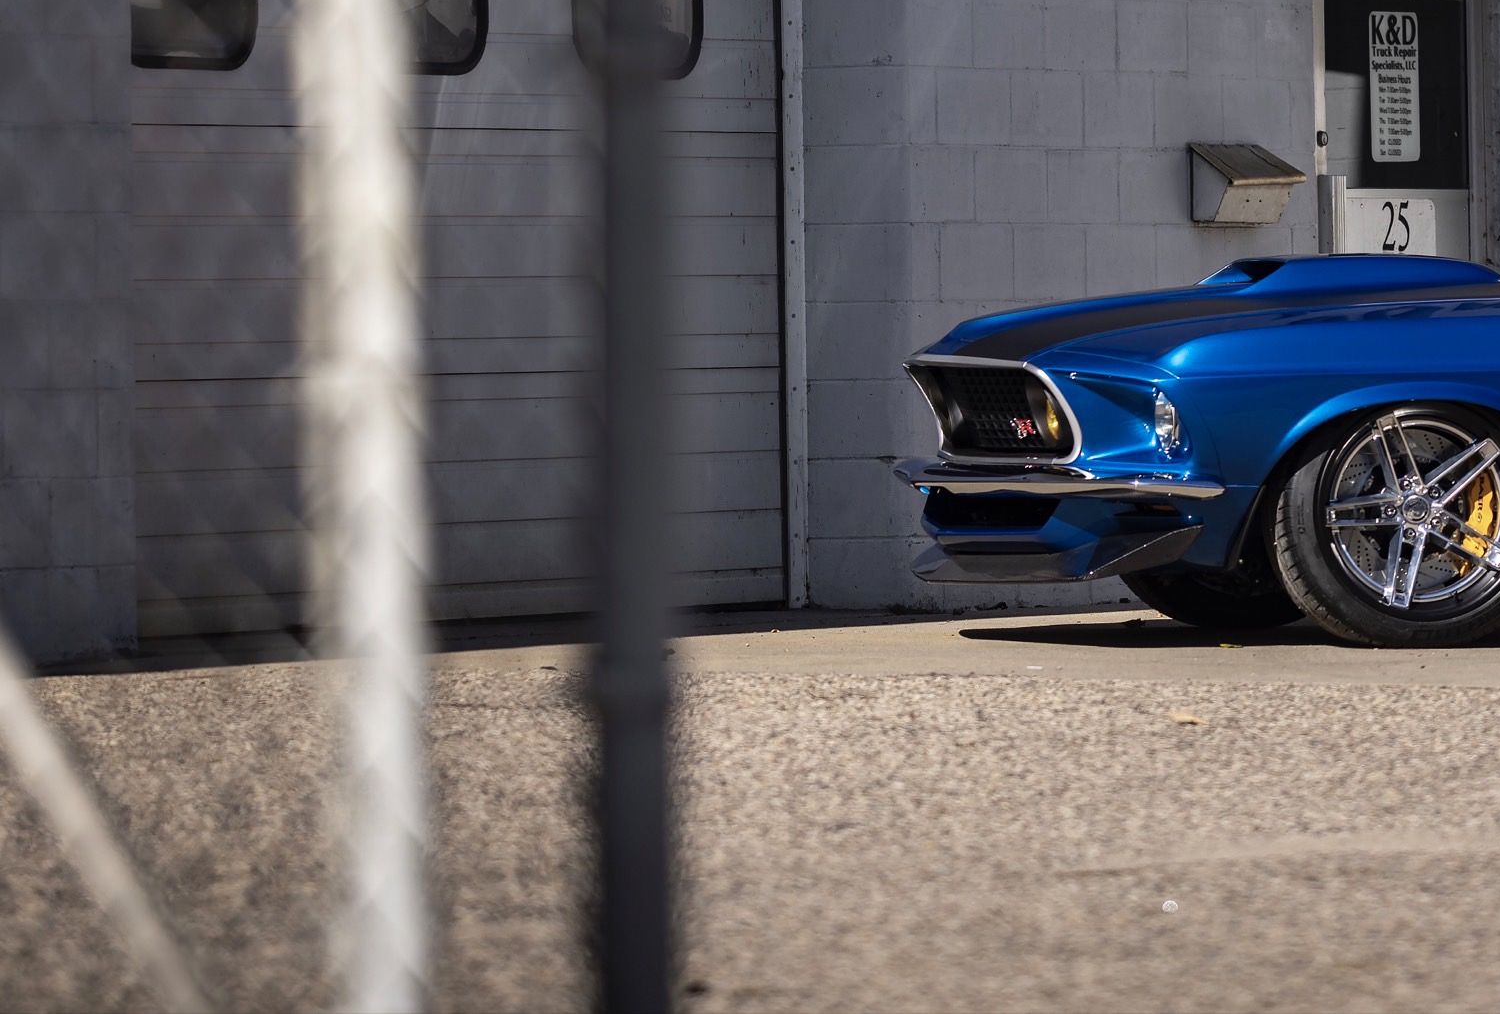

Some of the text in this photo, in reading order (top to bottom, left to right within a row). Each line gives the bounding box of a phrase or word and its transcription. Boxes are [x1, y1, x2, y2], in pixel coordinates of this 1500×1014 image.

[1371, 14, 1416, 45] K&D
[1371, 46, 1417, 60] Truck Repair
[1405, 60, 1416, 70] LLC
[1382, 200, 1410, 252] 25
